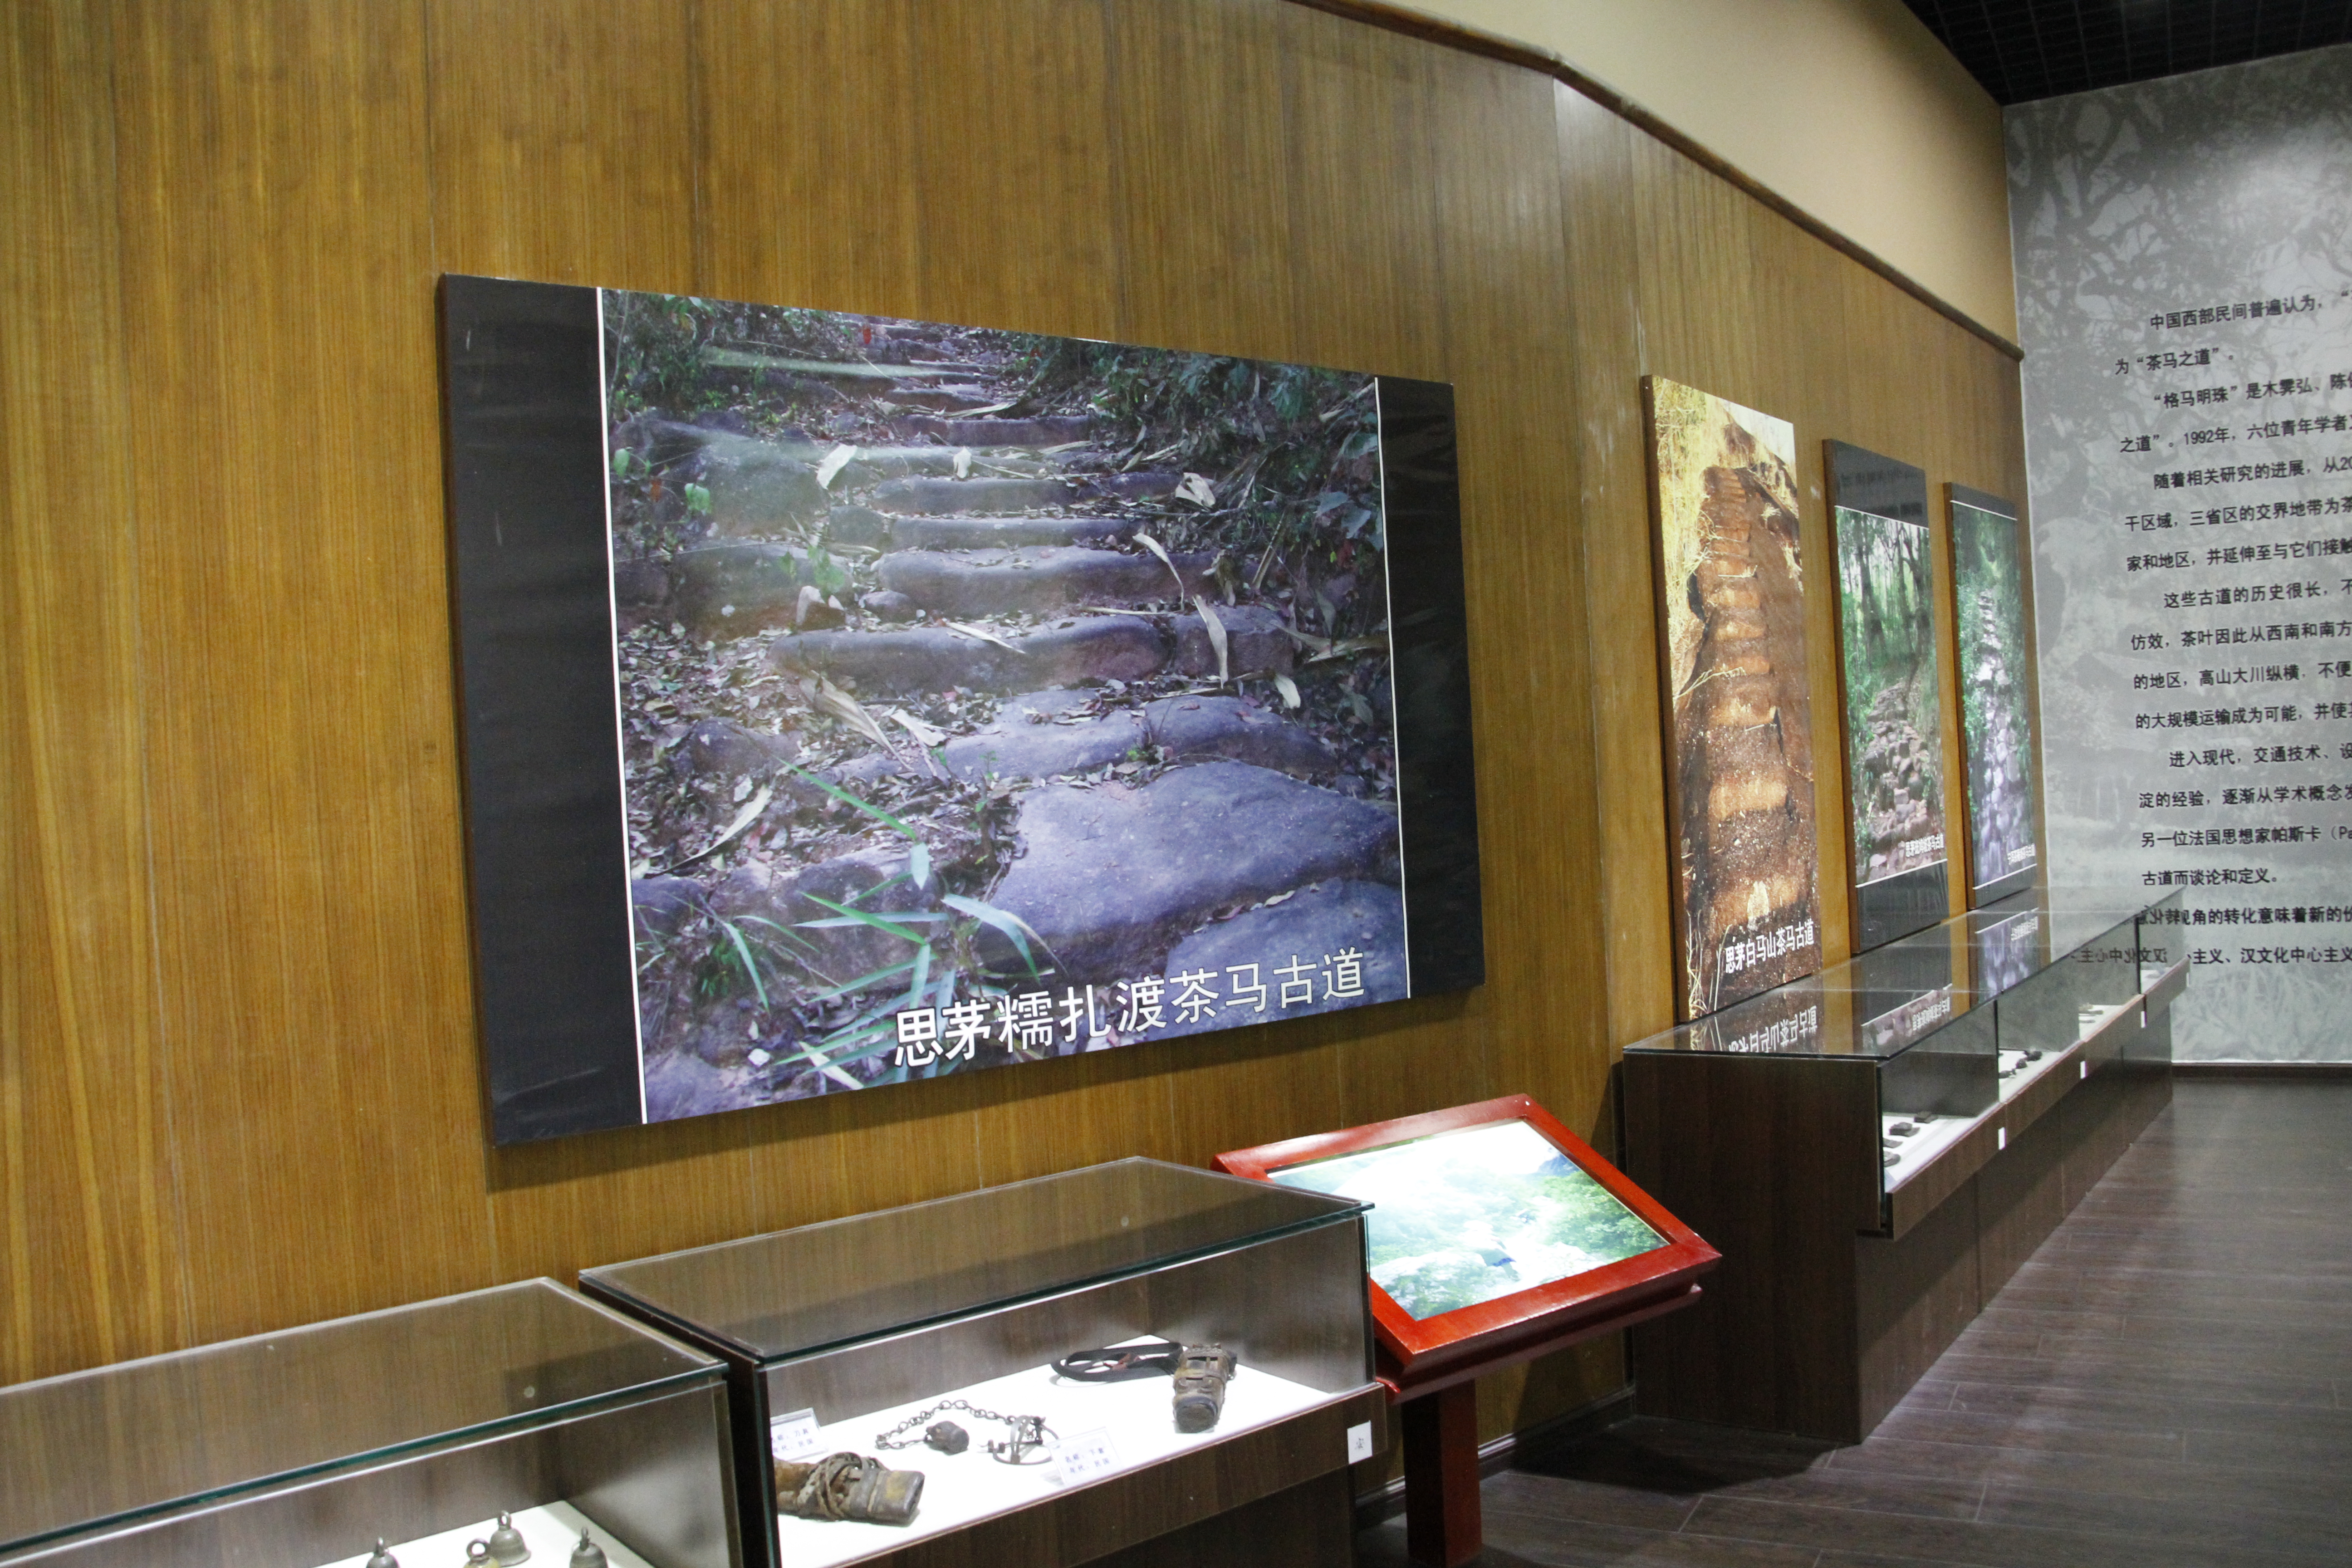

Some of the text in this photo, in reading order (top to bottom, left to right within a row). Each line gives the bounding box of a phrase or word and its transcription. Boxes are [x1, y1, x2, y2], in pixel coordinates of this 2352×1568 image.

[2150, 290, 2352, 330] 中国西部民间普遍认为，“
[2115, 348, 2233, 375] 为“茶马之道”。
[2120, 414, 2352, 453] 之道”。1992年，六位青年学者
[2164, 578, 2352, 608] 这些古道的历史很长，不
[2131, 620, 2352, 650] 仿效，茶叶因此从西南和南方
[2134, 660, 2352, 689] 的地区，高山大川纵横，不便
[2136, 701, 2352, 729] 的大规模运输成为可能，并使
[2142, 867, 2277, 886] 古道而谈论和定义。
[1725, 918, 1814, 974] 思茅白马山茶马古道
[2186, 946, 2352, 964] 主义、汉文化中心主义
[894, 946, 1364, 1068] 思茅糯扎渡茶马古道
